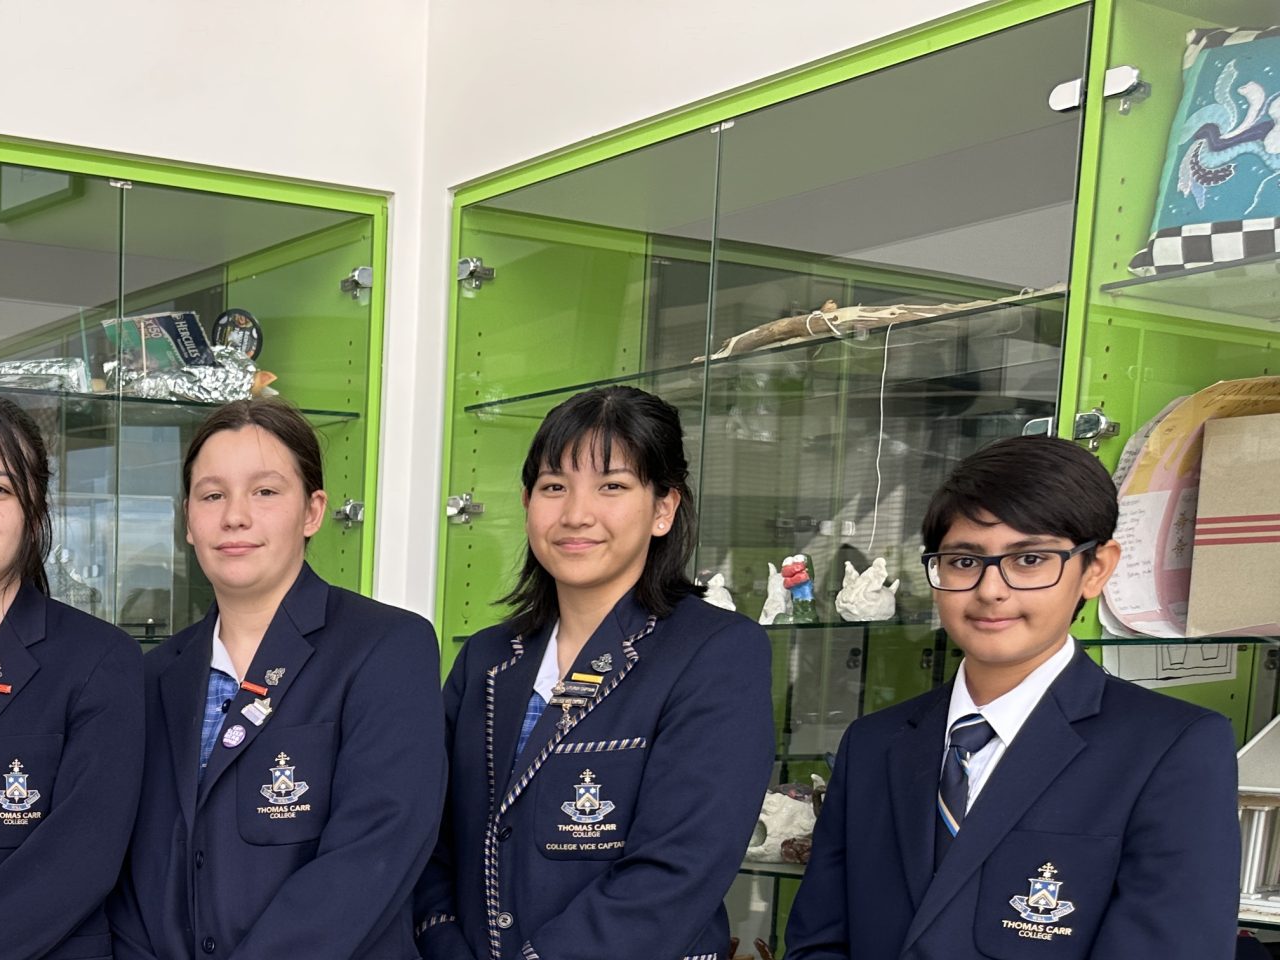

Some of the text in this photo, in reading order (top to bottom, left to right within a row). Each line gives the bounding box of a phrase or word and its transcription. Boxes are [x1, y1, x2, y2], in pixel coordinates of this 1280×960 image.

[175, 320, 200, 358] HERCULES
[257, 804, 311, 814] THOMAS CARR
[22, 811, 42, 819] CARR
[269, 811, 296, 819] COLLEGE
[557, 823, 617, 832] THOMAS CARR
[545, 843, 578, 851] COLLEGE
[579, 842, 597, 850] VICE
[1001, 920, 1073, 936] THOMAS CARR
[1018, 930, 1053, 941] COLLEGE
